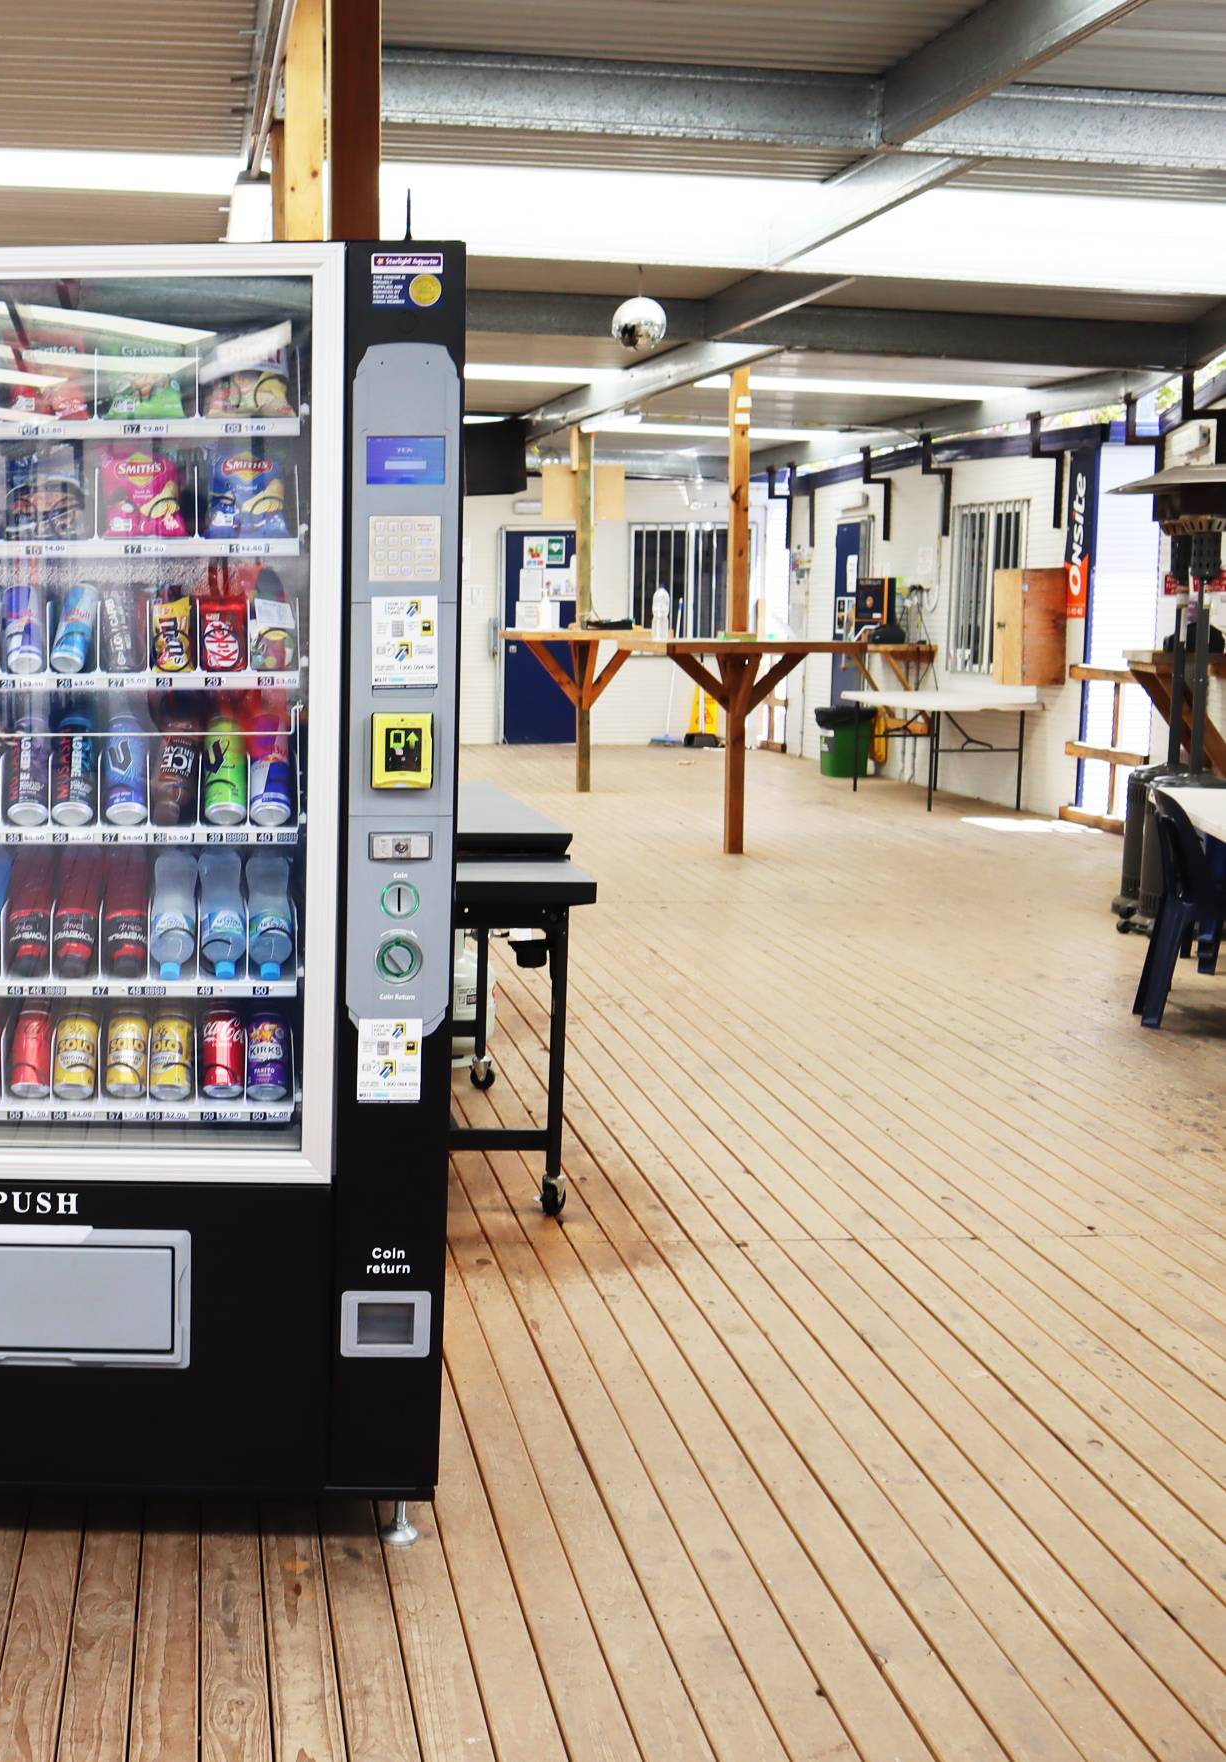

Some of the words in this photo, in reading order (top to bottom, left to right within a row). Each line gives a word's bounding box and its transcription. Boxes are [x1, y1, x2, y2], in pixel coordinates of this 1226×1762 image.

[117, 462, 162, 475] SMITH'S
[160, 752, 194, 774] ICE
[393, 871, 409, 879] Coin
[379, 992, 393, 1001] Coin
[394, 993, 416, 1001] Return
[59, 1039, 94, 1054] SOLO
[110, 1038, 146, 1053] SOLO
[154, 1039, 180, 1052] OLO
[249, 1045, 282, 1057] KIRKS
[371, 1247, 406, 1260] Coin
[366, 1262, 411, 1274] return
